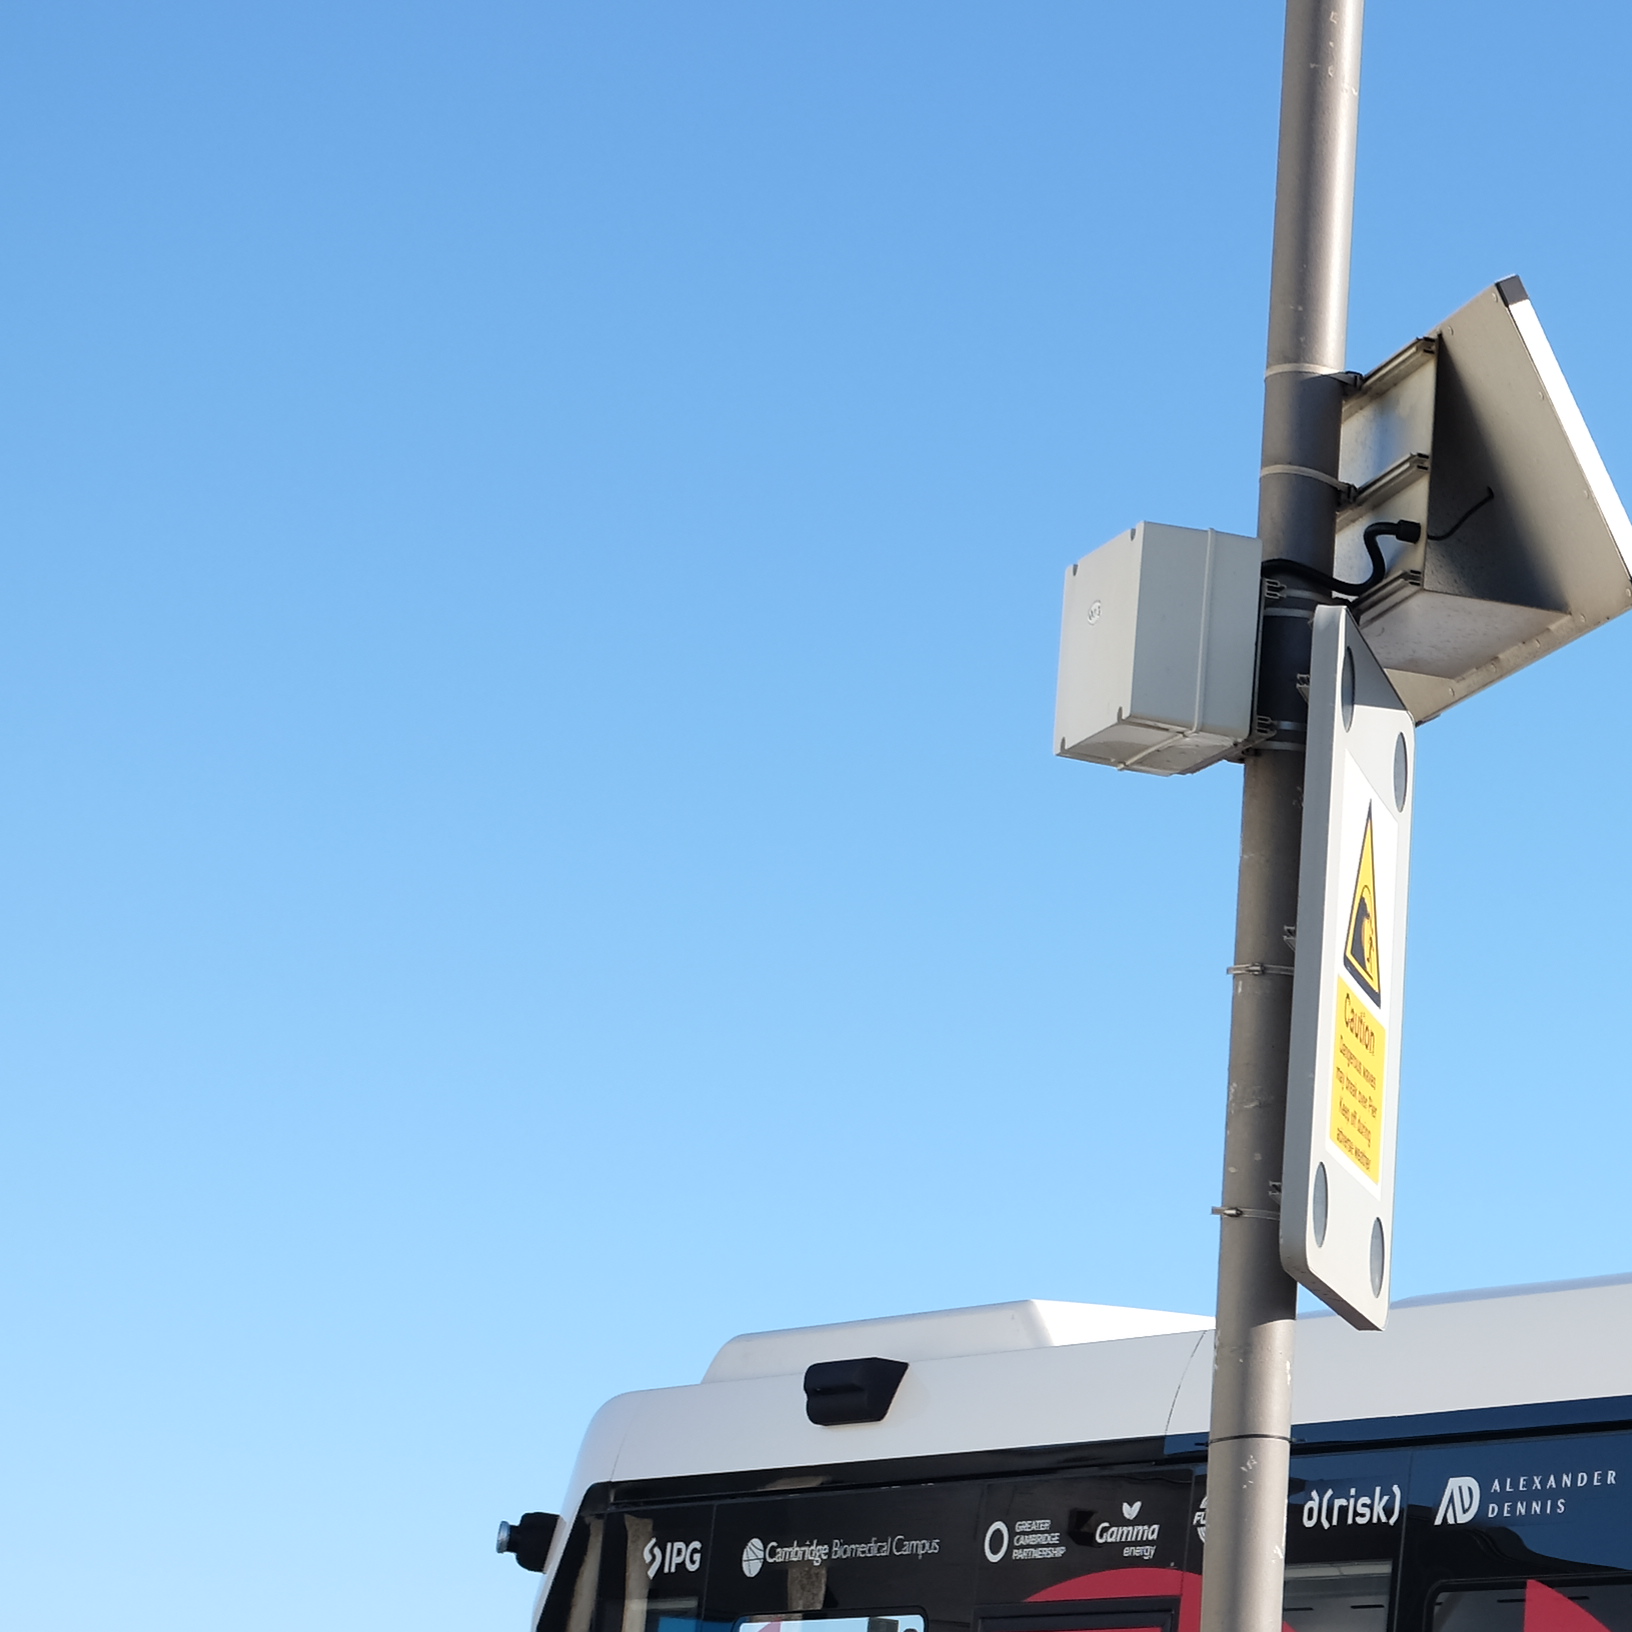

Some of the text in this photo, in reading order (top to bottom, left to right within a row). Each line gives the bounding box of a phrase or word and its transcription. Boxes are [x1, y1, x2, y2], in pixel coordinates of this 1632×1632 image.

[1343, 991, 1376, 1057] Caution
[1490, 1470, 1617, 1493] ALEXANDER
[1488, 1498, 1567, 1519] DENNIS
[1015, 1519, 1051, 1532] GREATER
[1095, 1522, 1160, 1544] Gamma
[1013, 1533, 1060, 1546] CAMBRIDGE
[663, 1541, 702, 1575] IPG
[765, 1535, 940, 1566] Cambridge Biomedical Campus
[1012, 1546, 1067, 1560] PARTNERSHIP
[1122, 1544, 1155, 1560] energy
